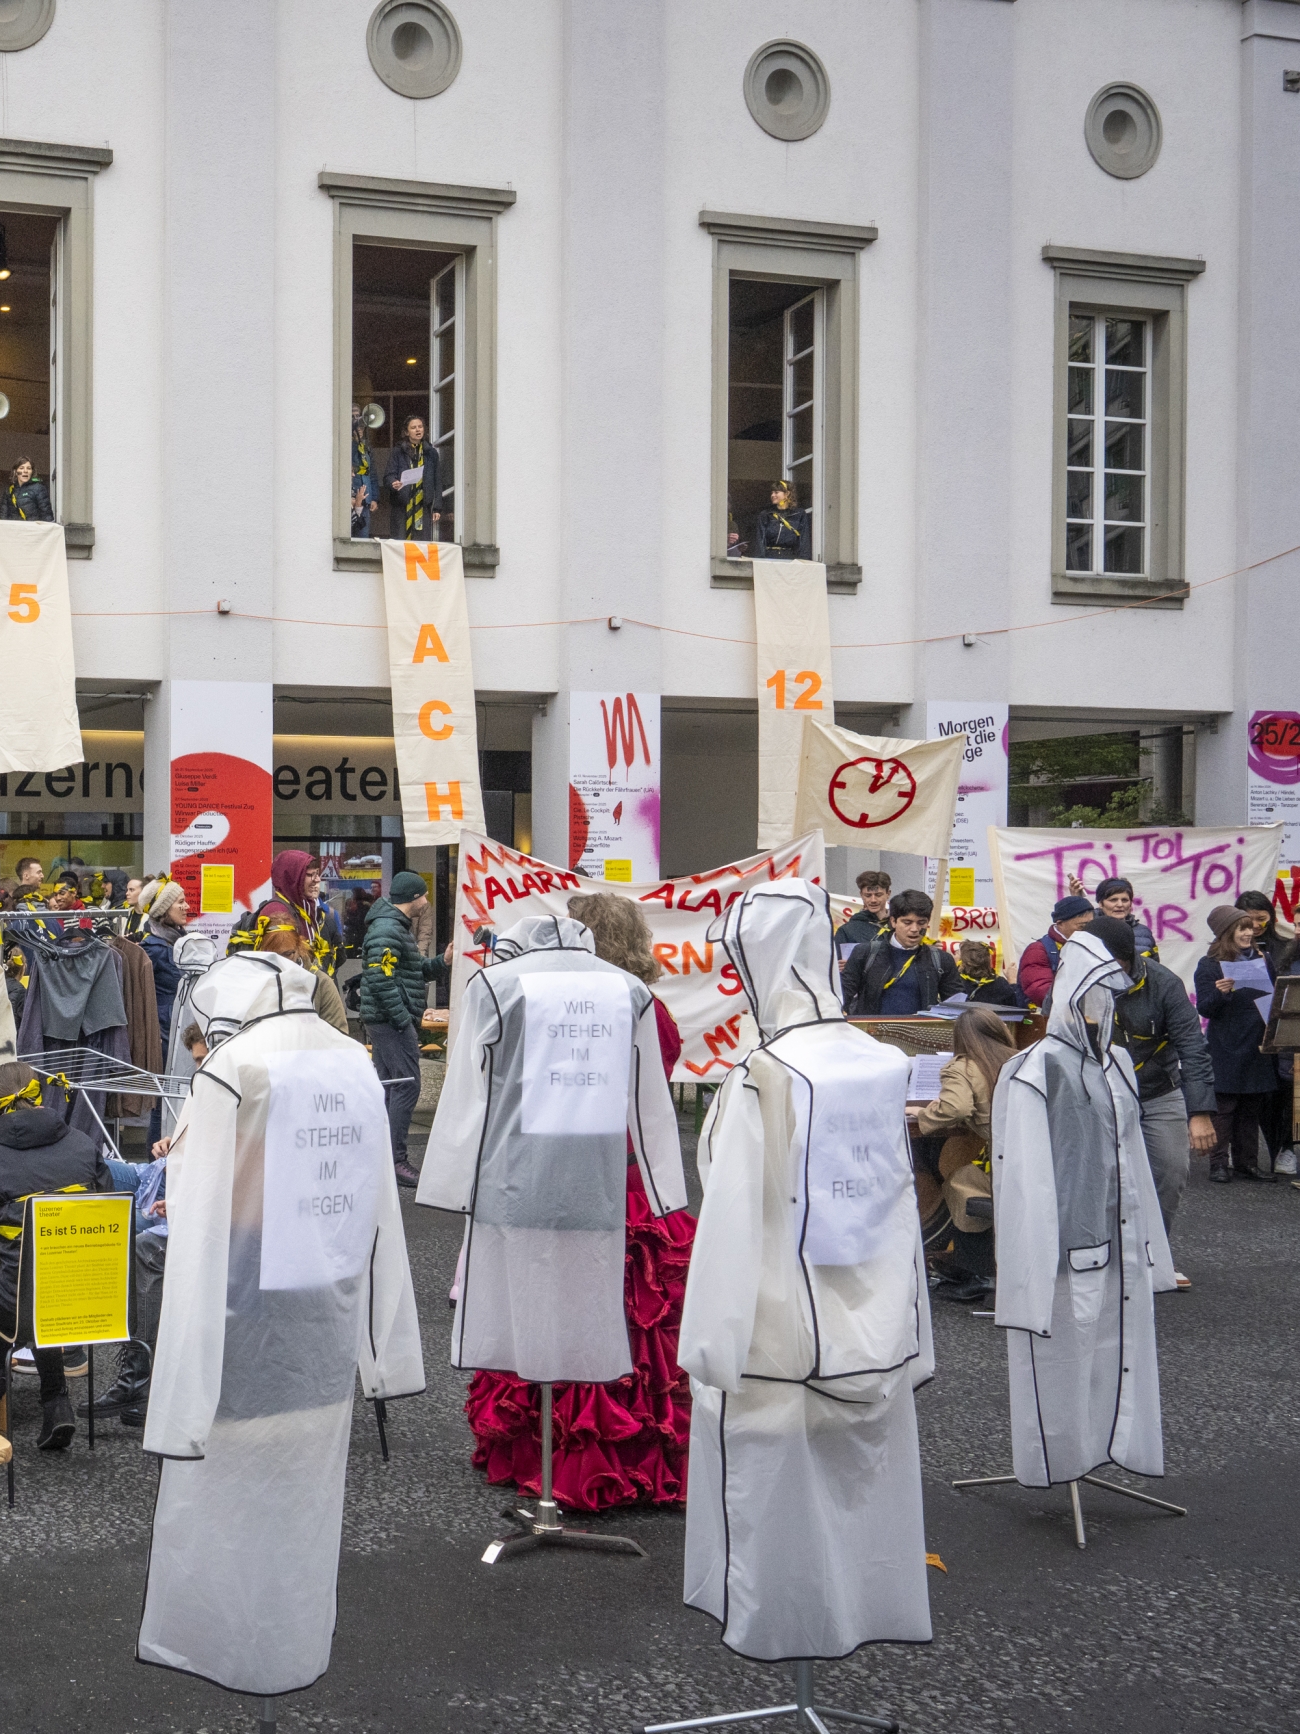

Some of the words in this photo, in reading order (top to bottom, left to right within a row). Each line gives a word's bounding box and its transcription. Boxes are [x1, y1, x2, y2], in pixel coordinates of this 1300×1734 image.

[7, 583, 41, 624] 5
[403, 542, 464, 822] NACH
[766, 669, 823, 710] 12
[938, 716, 995, 737] Morgen
[975, 730, 995, 744] die
[1160, 836, 1245, 900] Toi
[484, 871, 581, 910] ALARM
[952, 906, 1000, 932] BRÖ
[564, 1001, 595, 1015] WIR
[547, 1024, 612, 1038] STEHEN
[571, 1047, 589, 1061] IM
[550, 1072, 609, 1086] REGEN
[313, 1093, 346, 1113] WIR
[295, 1125, 363, 1149] STEHEN
[852, 1145, 869, 1162] IM
[318, 1160, 337, 1180] IM
[298, 1193, 354, 1217] REGEN
[40, 1227, 52, 1236] Es
[55, 1226, 67, 1235] ist
[70, 1225, 77, 1234] 5
[80, 1224, 105, 1234] nach
[108, 1223, 119, 1233] 12
